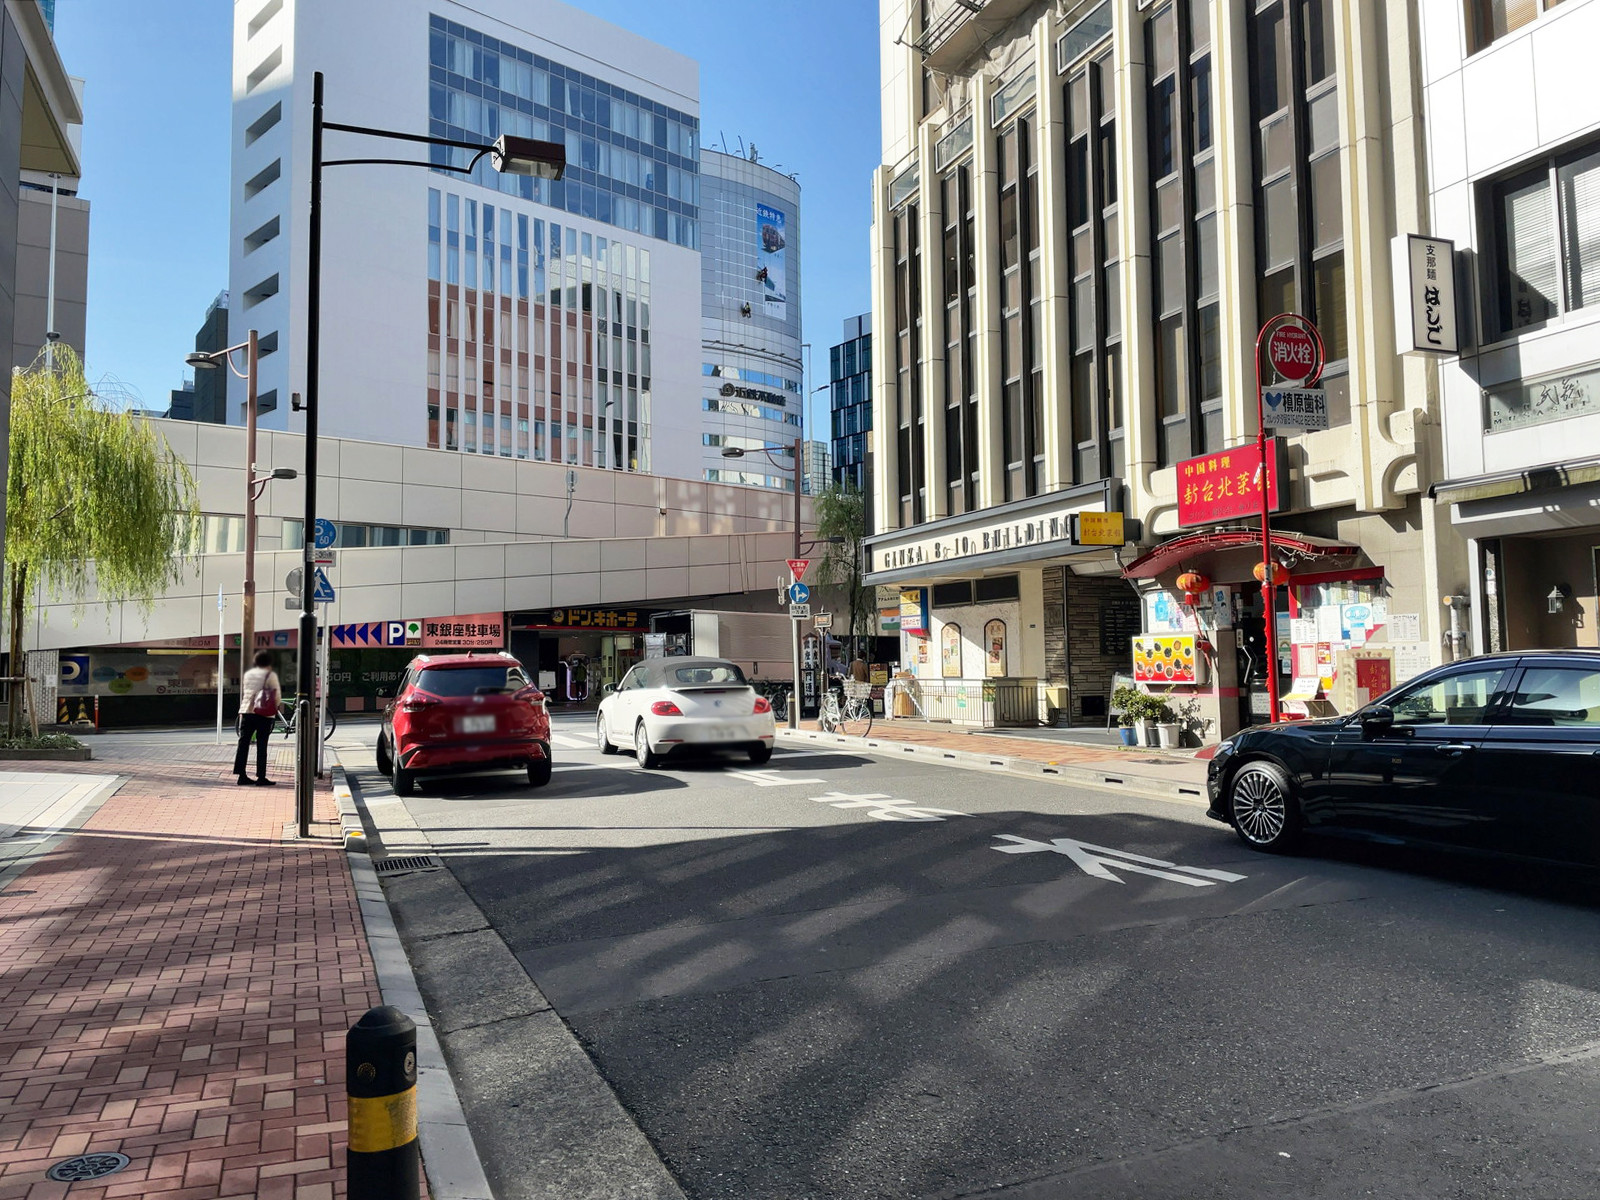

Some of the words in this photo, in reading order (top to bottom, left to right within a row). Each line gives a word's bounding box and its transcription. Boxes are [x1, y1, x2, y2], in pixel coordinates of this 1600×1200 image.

[1273, 341, 1312, 364] 消火栓
[1184, 456, 1230, 477] 中国料理
[884, 545, 923, 568] GINZA
[389, 623, 404, 644] P
[426, 623, 501, 637] 東銀座駐車場
[257, 637, 270, 646] IN
